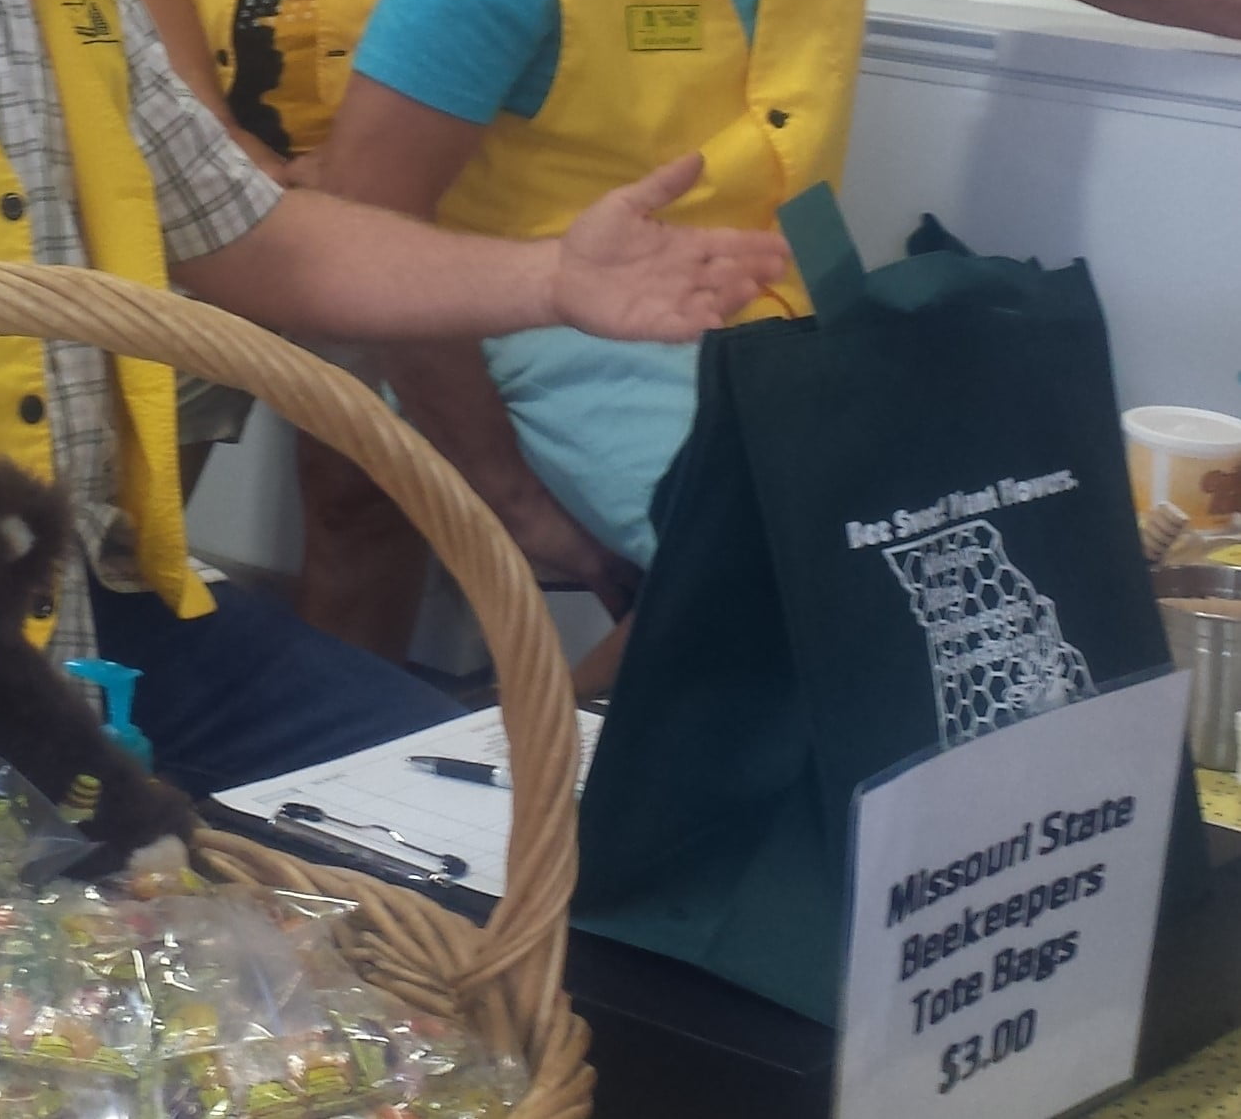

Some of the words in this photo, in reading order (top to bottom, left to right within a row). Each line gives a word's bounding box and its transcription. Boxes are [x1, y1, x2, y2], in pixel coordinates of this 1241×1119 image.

[845, 521, 894, 549] Bee
[886, 821, 1033, 928] Missouri
[1039, 795, 1136, 856] State
[899, 863, 1107, 981] Beekeepers
[912, 971, 984, 1035] Tote
[991, 930, 1081, 993] Bags
[937, 1007, 1037, 1095] $3.00
